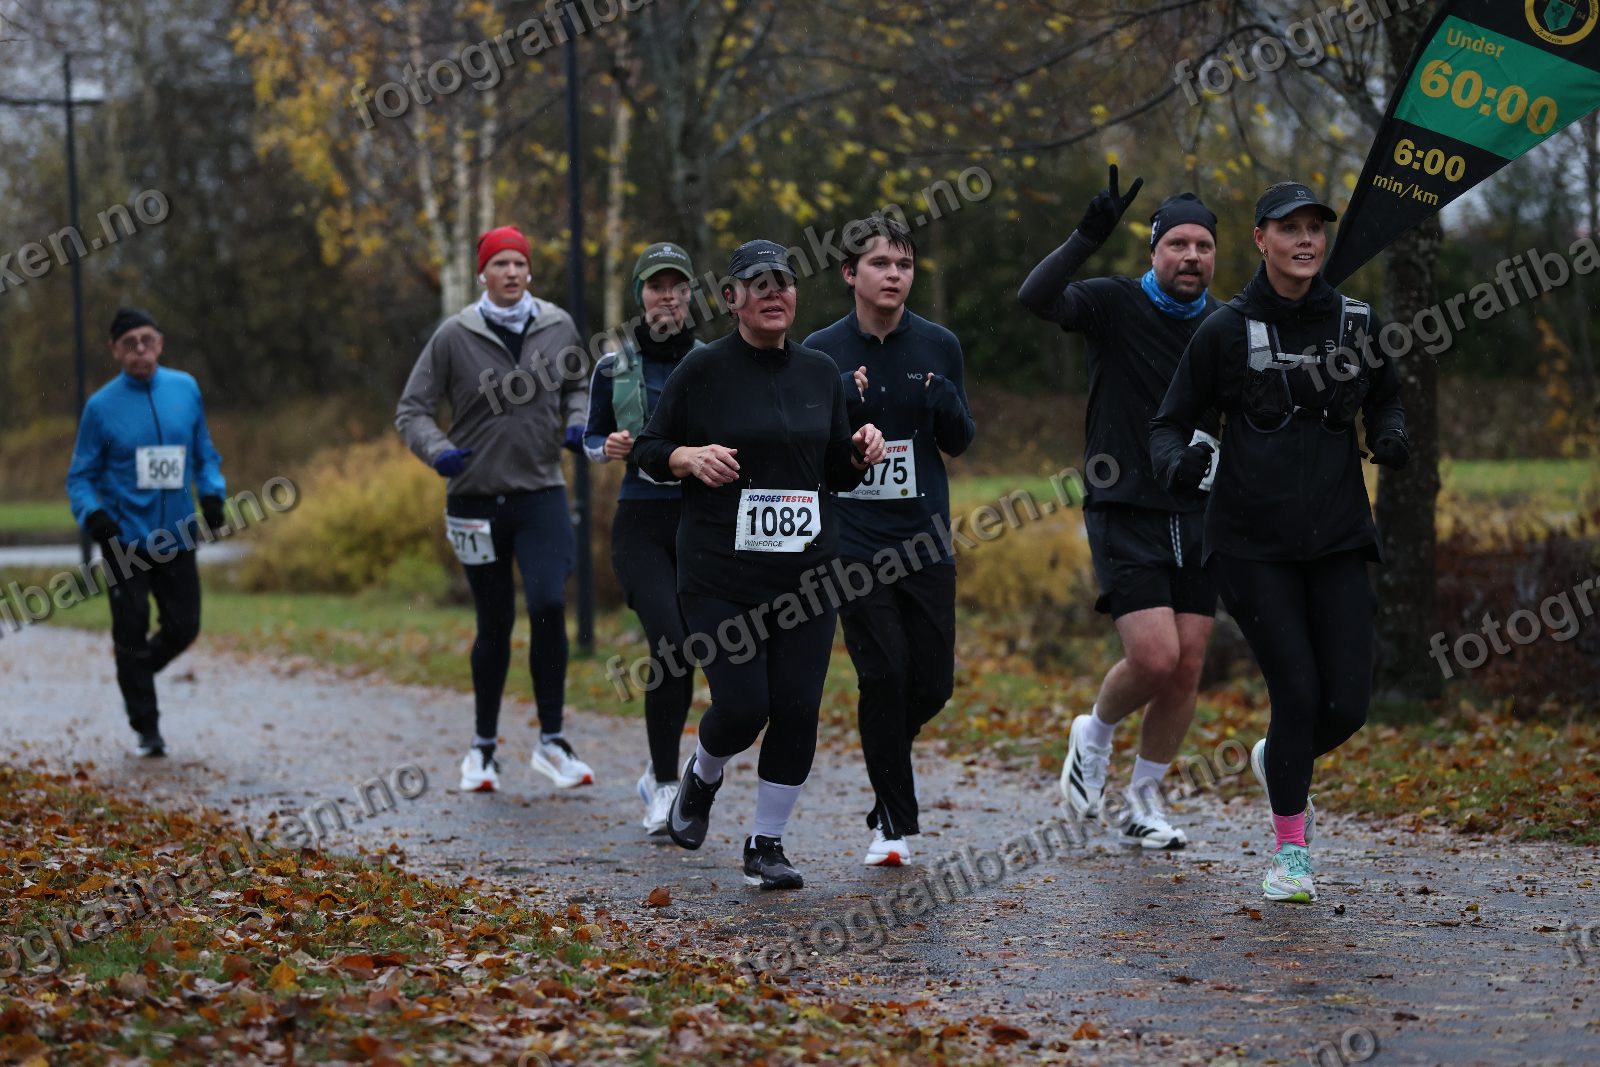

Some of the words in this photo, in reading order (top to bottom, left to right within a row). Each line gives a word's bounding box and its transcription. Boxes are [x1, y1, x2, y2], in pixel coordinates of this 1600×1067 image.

[1447, 28, 1505, 58] Under
[1420, 59, 1558, 135] 60:00
[1393, 138, 1466, 182] 6:00
[1373, 173, 1440, 206] min/km
[149, 458, 180, 479] 506
[747, 495, 813, 503] NORGESTESTEN
[747, 506, 813, 536] 1082
